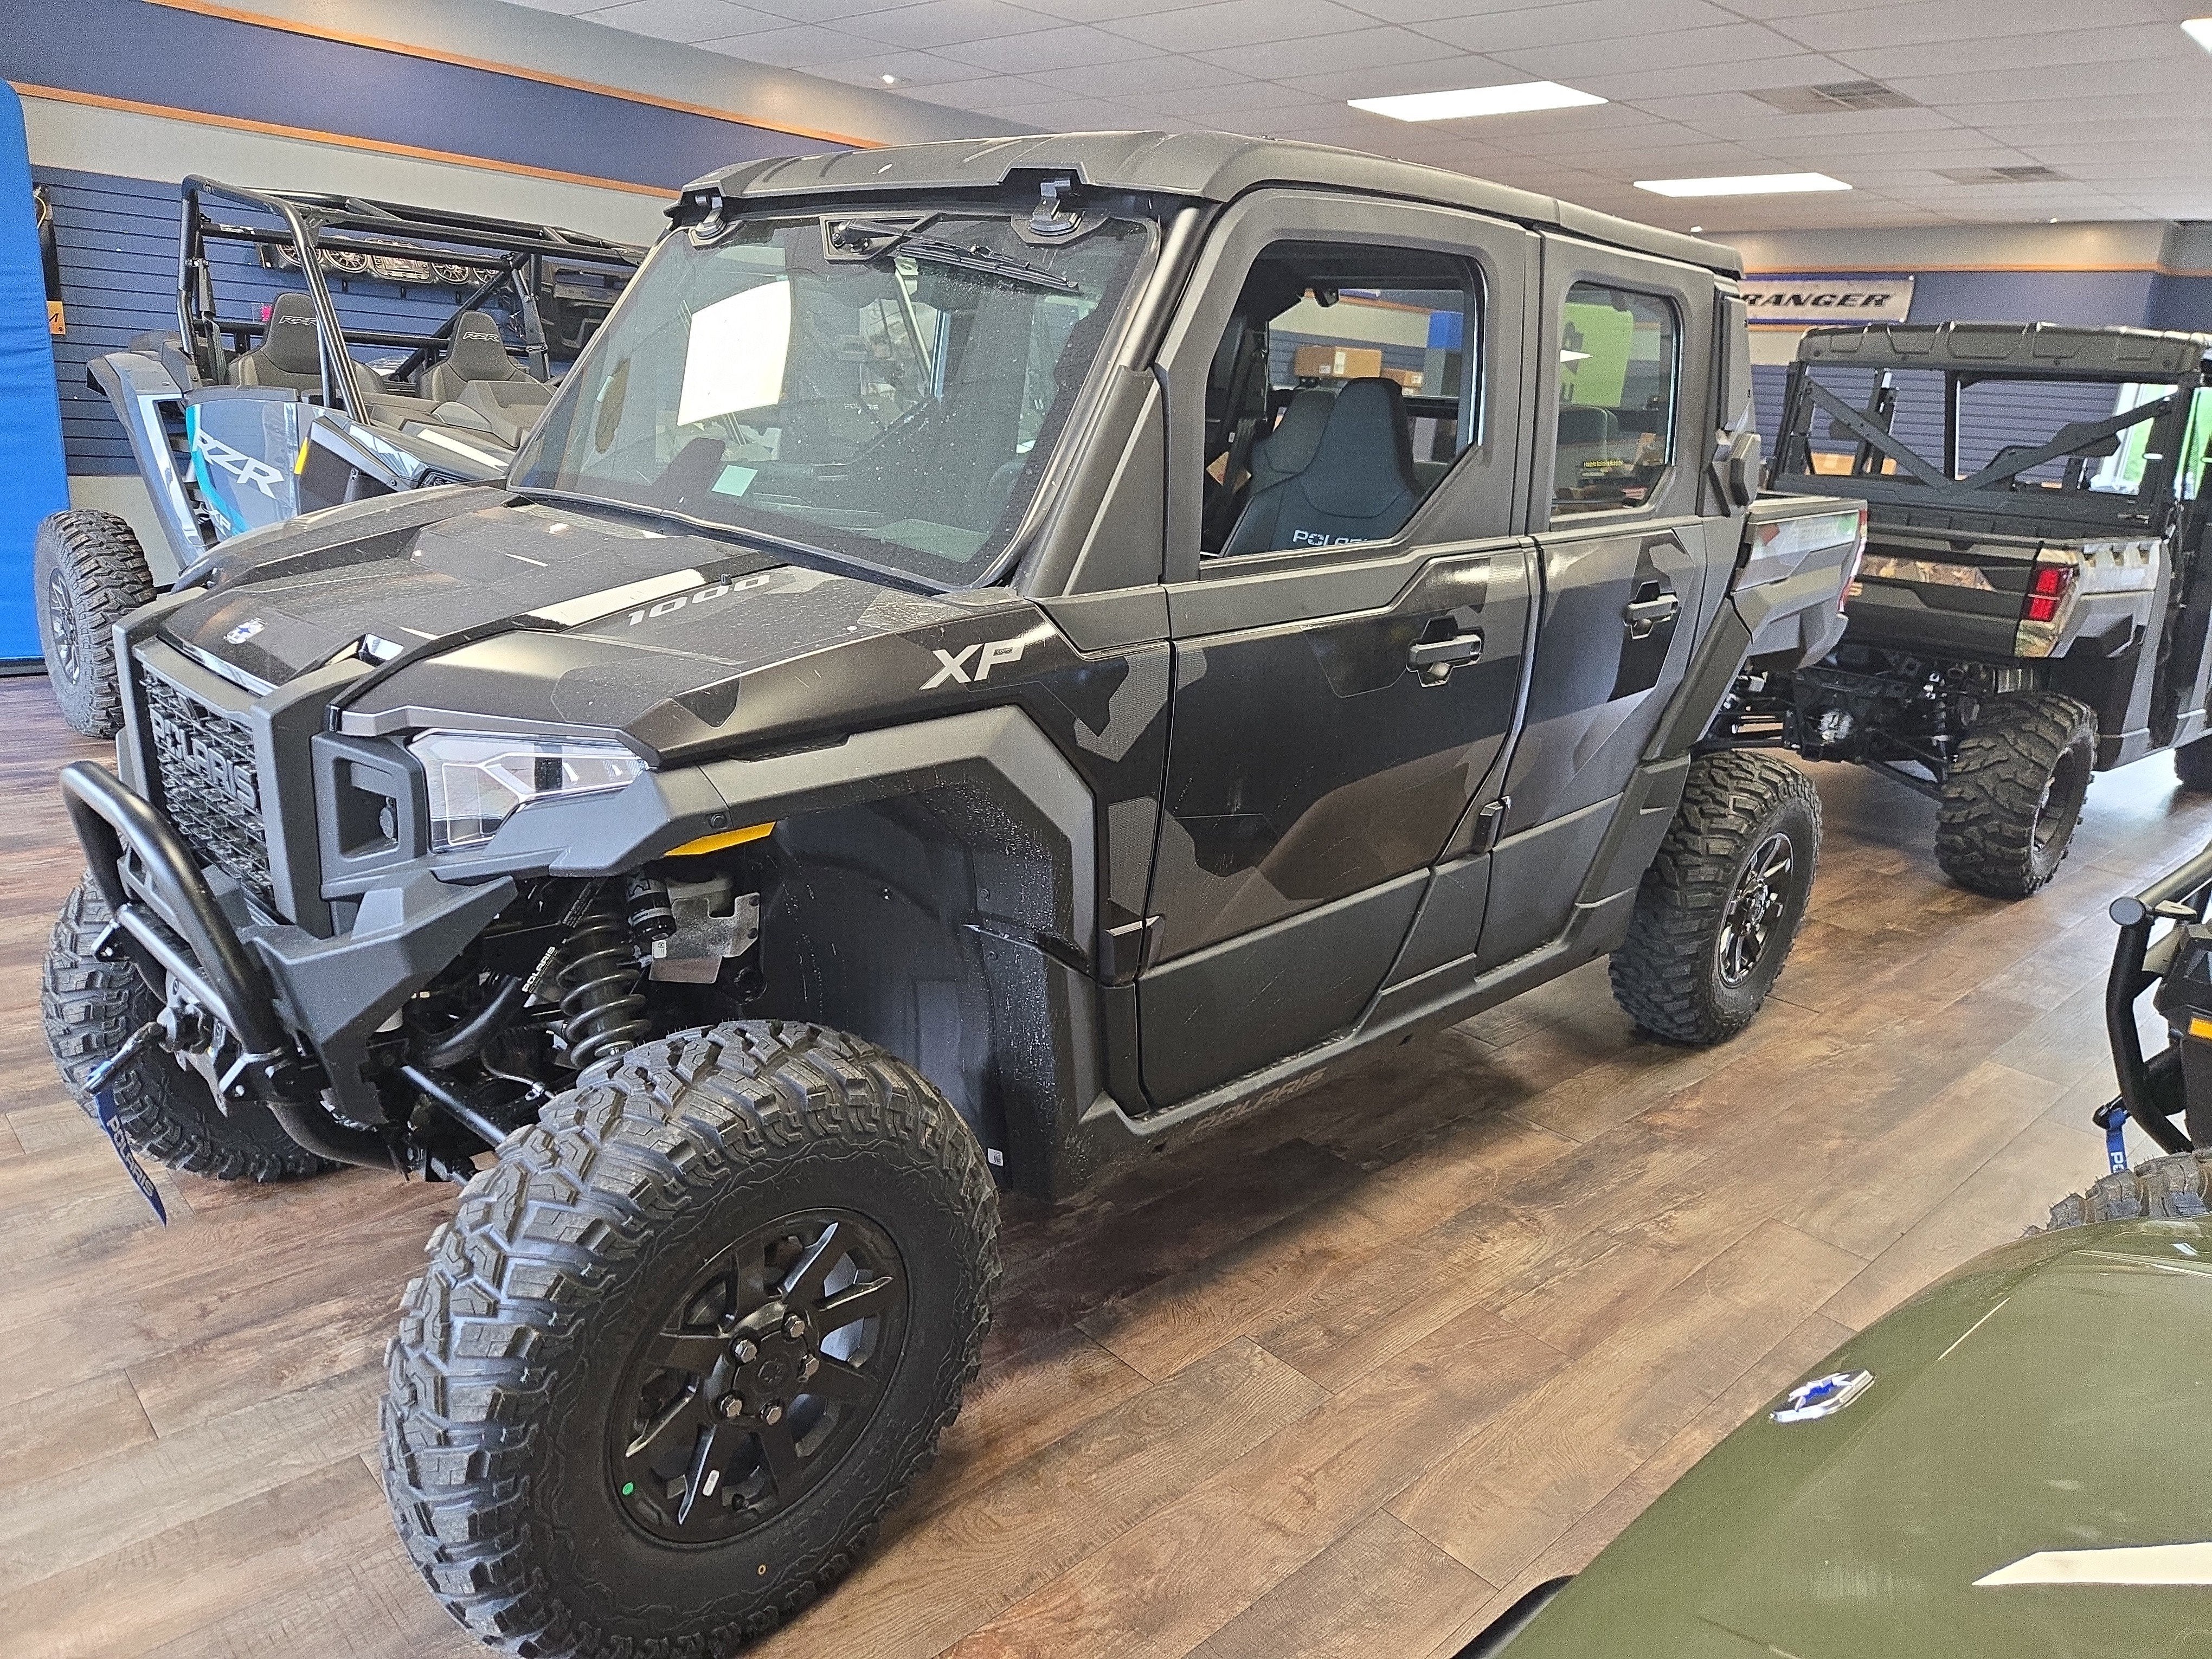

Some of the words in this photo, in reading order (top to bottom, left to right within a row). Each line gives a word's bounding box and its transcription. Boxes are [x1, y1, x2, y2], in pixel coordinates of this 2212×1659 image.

[462, 331, 500, 343] RZR
[192, 426, 285, 500] RZR
[627, 575, 770, 626] 1000
[919, 637, 1025, 690] XP
[149, 703, 257, 811] POLARIS
[522, 946, 556, 993] POLARIS
[106, 1114, 155, 1197] POLARIS
